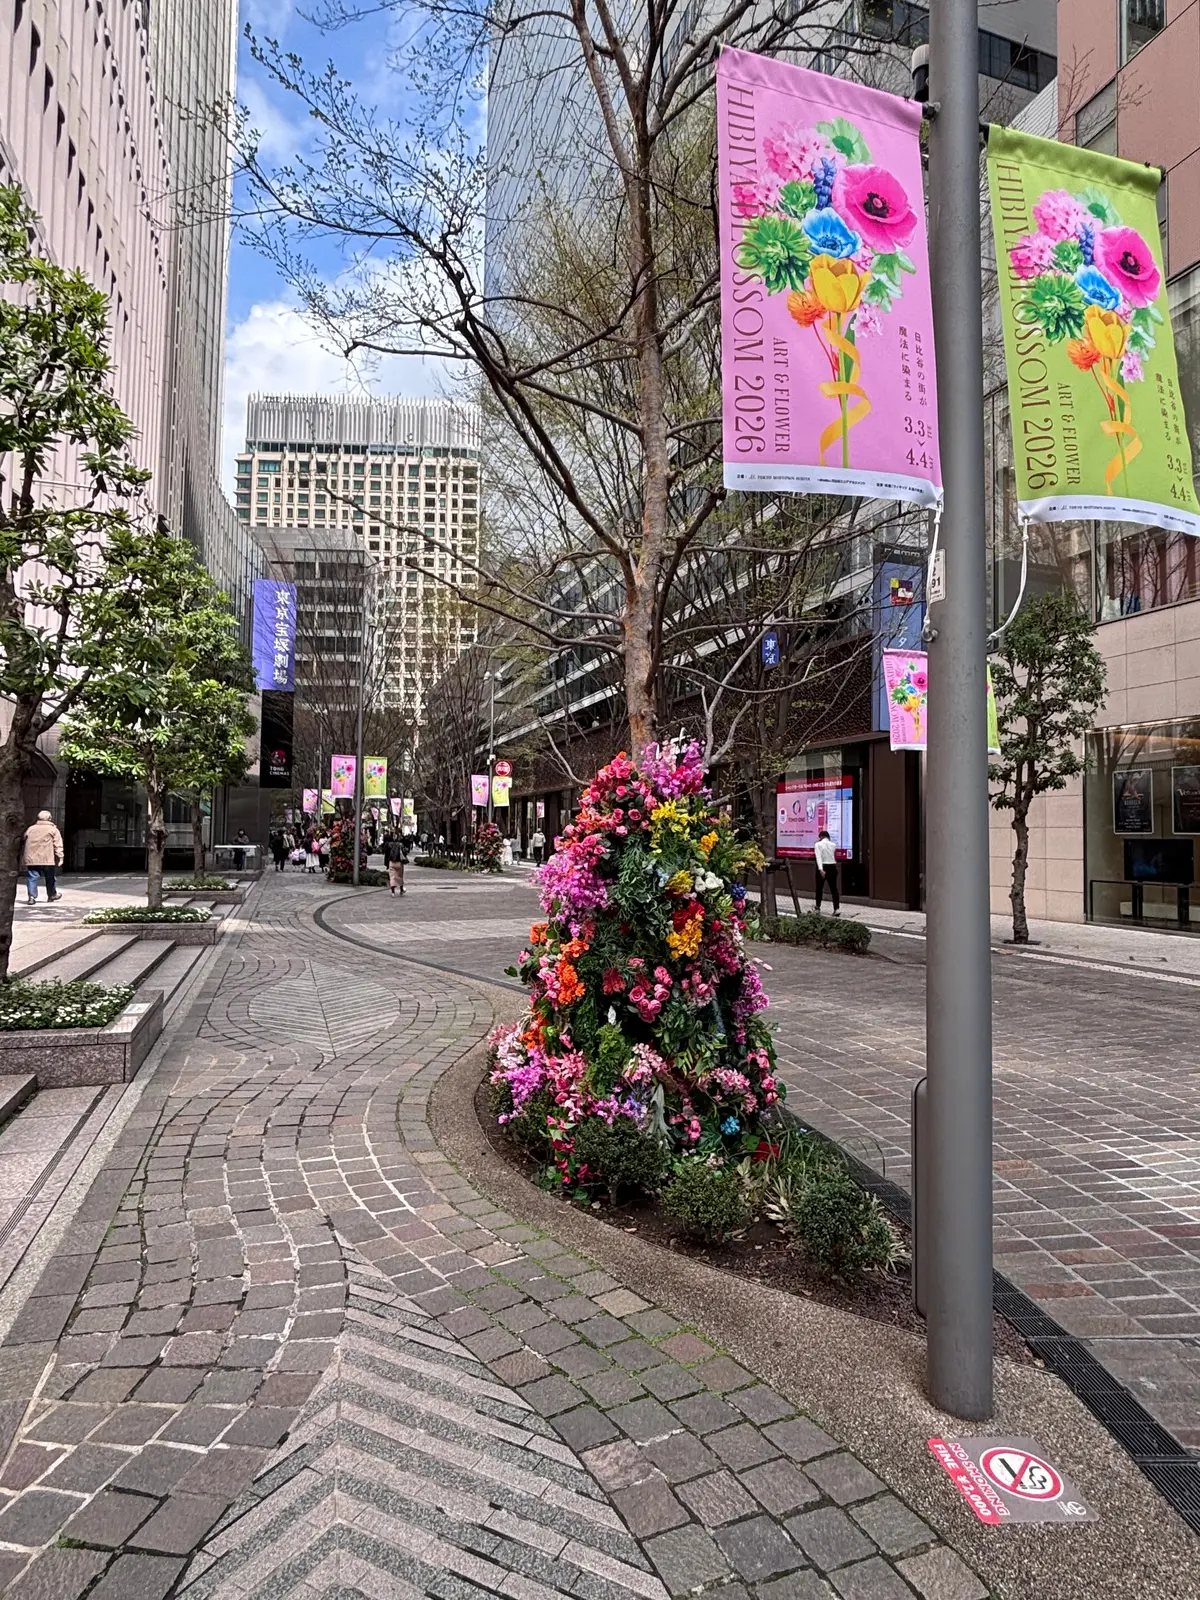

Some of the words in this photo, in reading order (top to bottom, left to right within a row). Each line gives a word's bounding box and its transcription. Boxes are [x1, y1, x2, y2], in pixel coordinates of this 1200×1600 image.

[727, 83, 757, 187] HIBIYA
[996, 163, 1031, 254] HIBIYA
[731, 202, 765, 363] BLOSSOM
[773, 337, 789, 368] ART
[898, 325, 912, 402] 魔法に染まる
[914, 331, 928, 406] 日比谷の街が
[1007, 265, 1051, 410] BLOSSOM
[734, 375, 766, 453] 2026
[774, 373, 790, 384] &
[1057, 382, 1075, 409] ART
[774, 388, 790, 453] FLOWER
[904, 416, 925, 438] 3.3
[1023, 417, 1059, 490] 2026
[1061, 414, 1075, 423] &
[905, 448, 928, 469] 4.4
[1062, 428, 1081, 485] FLOWER
[1167, 454, 1182, 473] 3.3
[1170, 483, 1186, 502] 4.4
[273, 588, 291, 685] 東京宝塚劇場
[933, 1444, 960, 1469] FINE
[957, 1475, 992, 1516] ¥2,000
[948, 1442, 969, 1460] NO
[962, 1460, 1011, 1516] SMOKING
